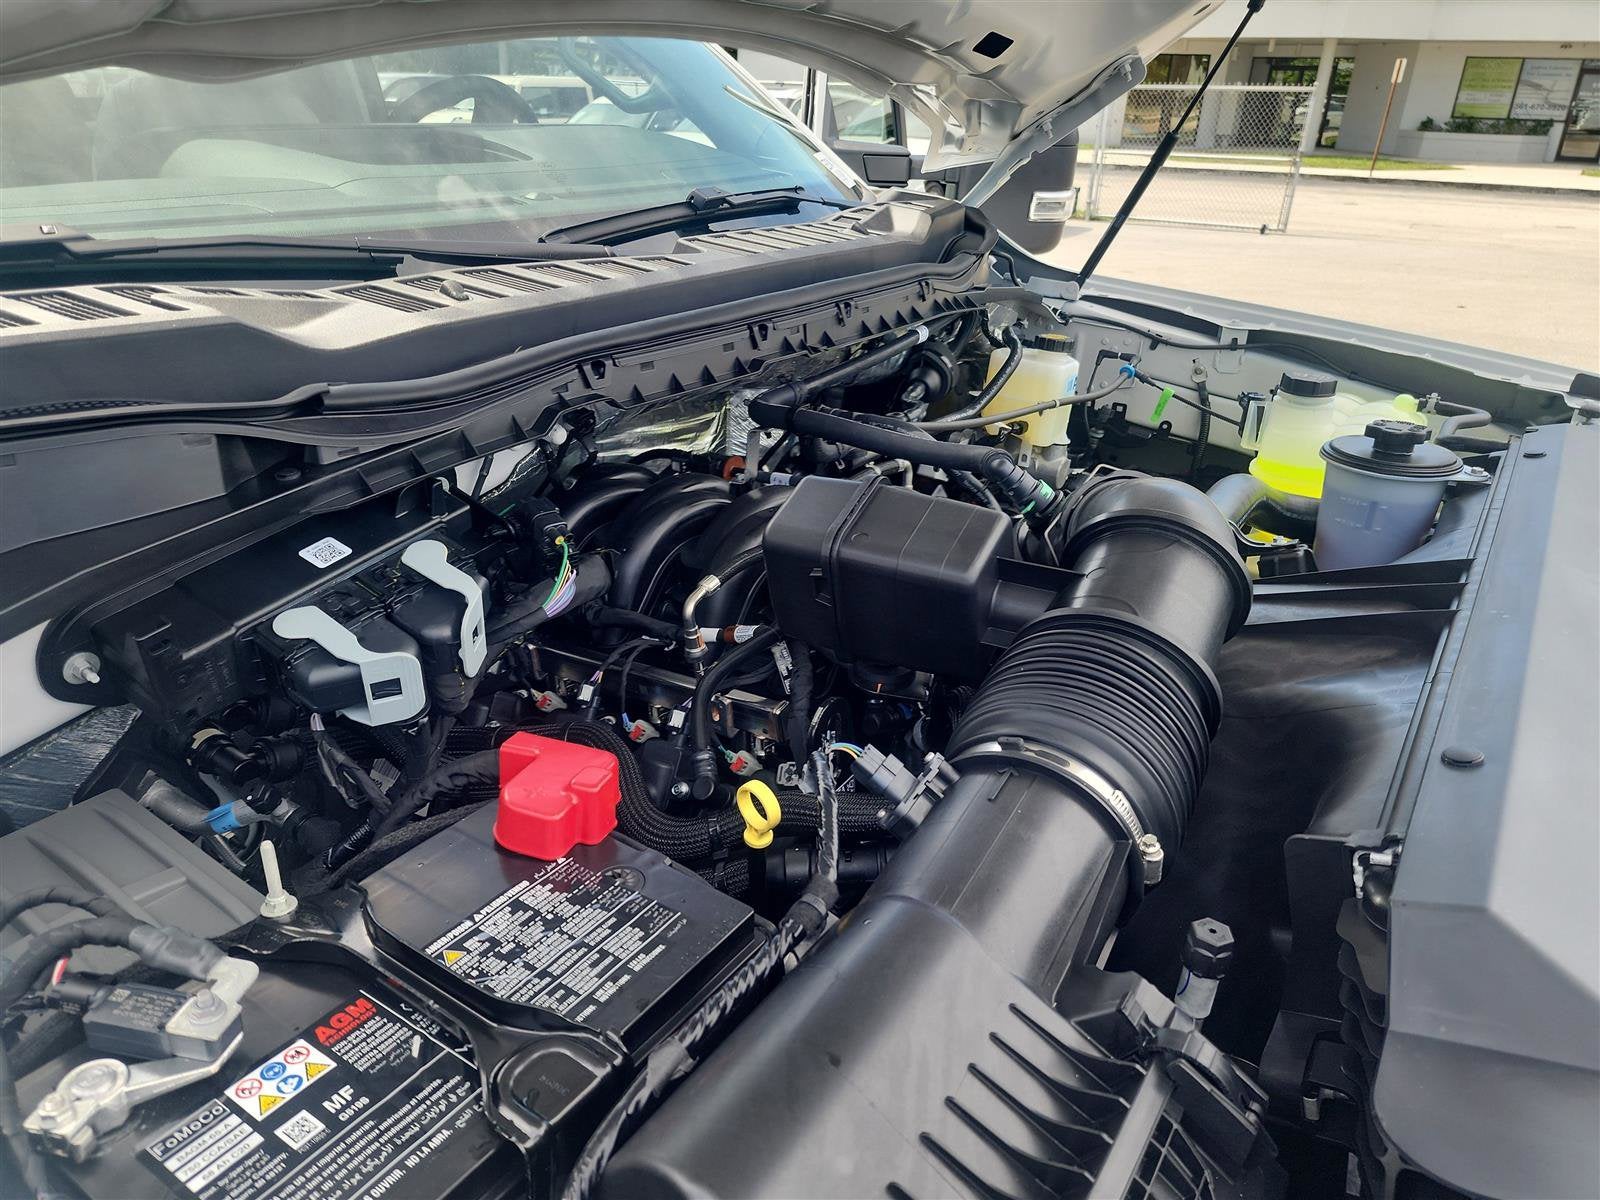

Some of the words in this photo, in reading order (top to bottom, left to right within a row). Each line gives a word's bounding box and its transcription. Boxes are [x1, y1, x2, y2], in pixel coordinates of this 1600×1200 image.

[425, 920, 473, 954] ANGER/POISON
[315, 998, 374, 1042] AGM
[322, 1085, 353, 1113] MF
[153, 1105, 223, 1155] FoMoCo
